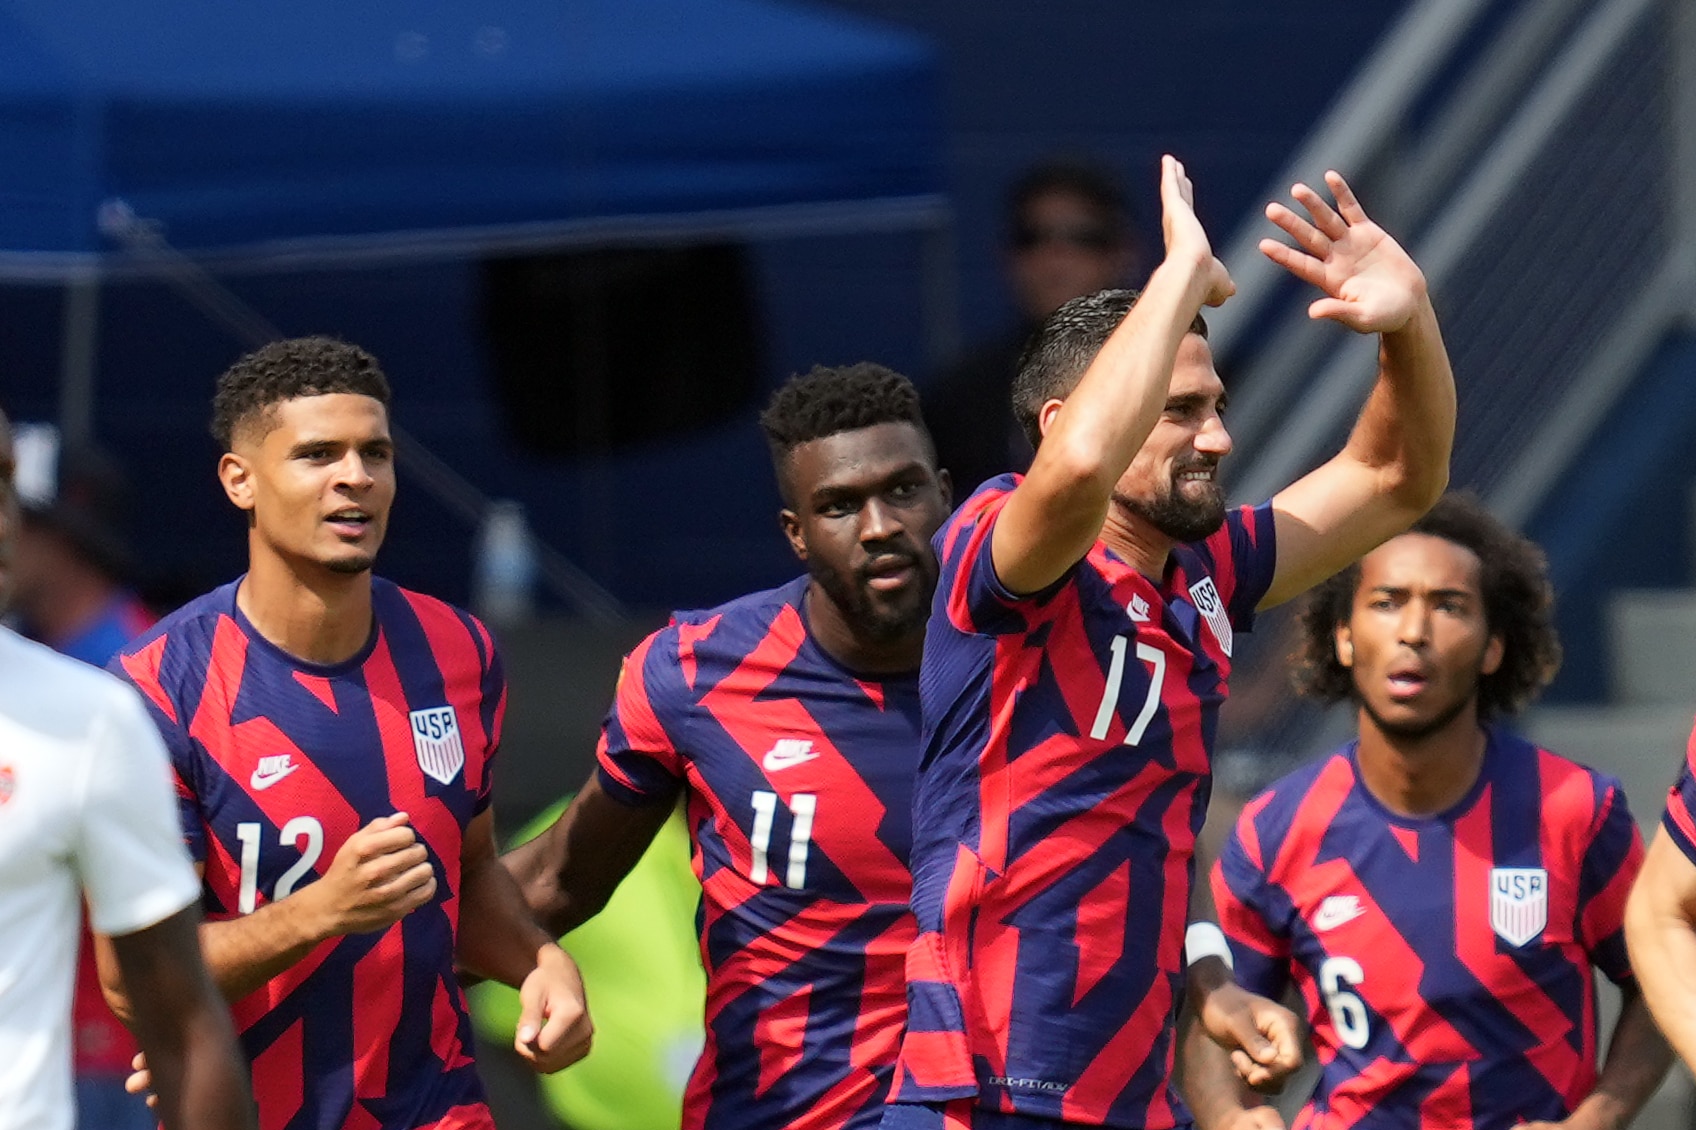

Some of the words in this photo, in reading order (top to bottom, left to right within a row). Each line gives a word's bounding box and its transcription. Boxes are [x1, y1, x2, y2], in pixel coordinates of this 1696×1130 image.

[1192, 582, 1218, 613] USA
[1089, 634, 1166, 747] 17
[415, 711, 454, 740] USA
[257, 754, 292, 776] NIKE
[236, 815, 324, 915] 12
[751, 790, 817, 889] 11
[1497, 875, 1541, 900] USA
[1319, 956, 1370, 1049] 6
